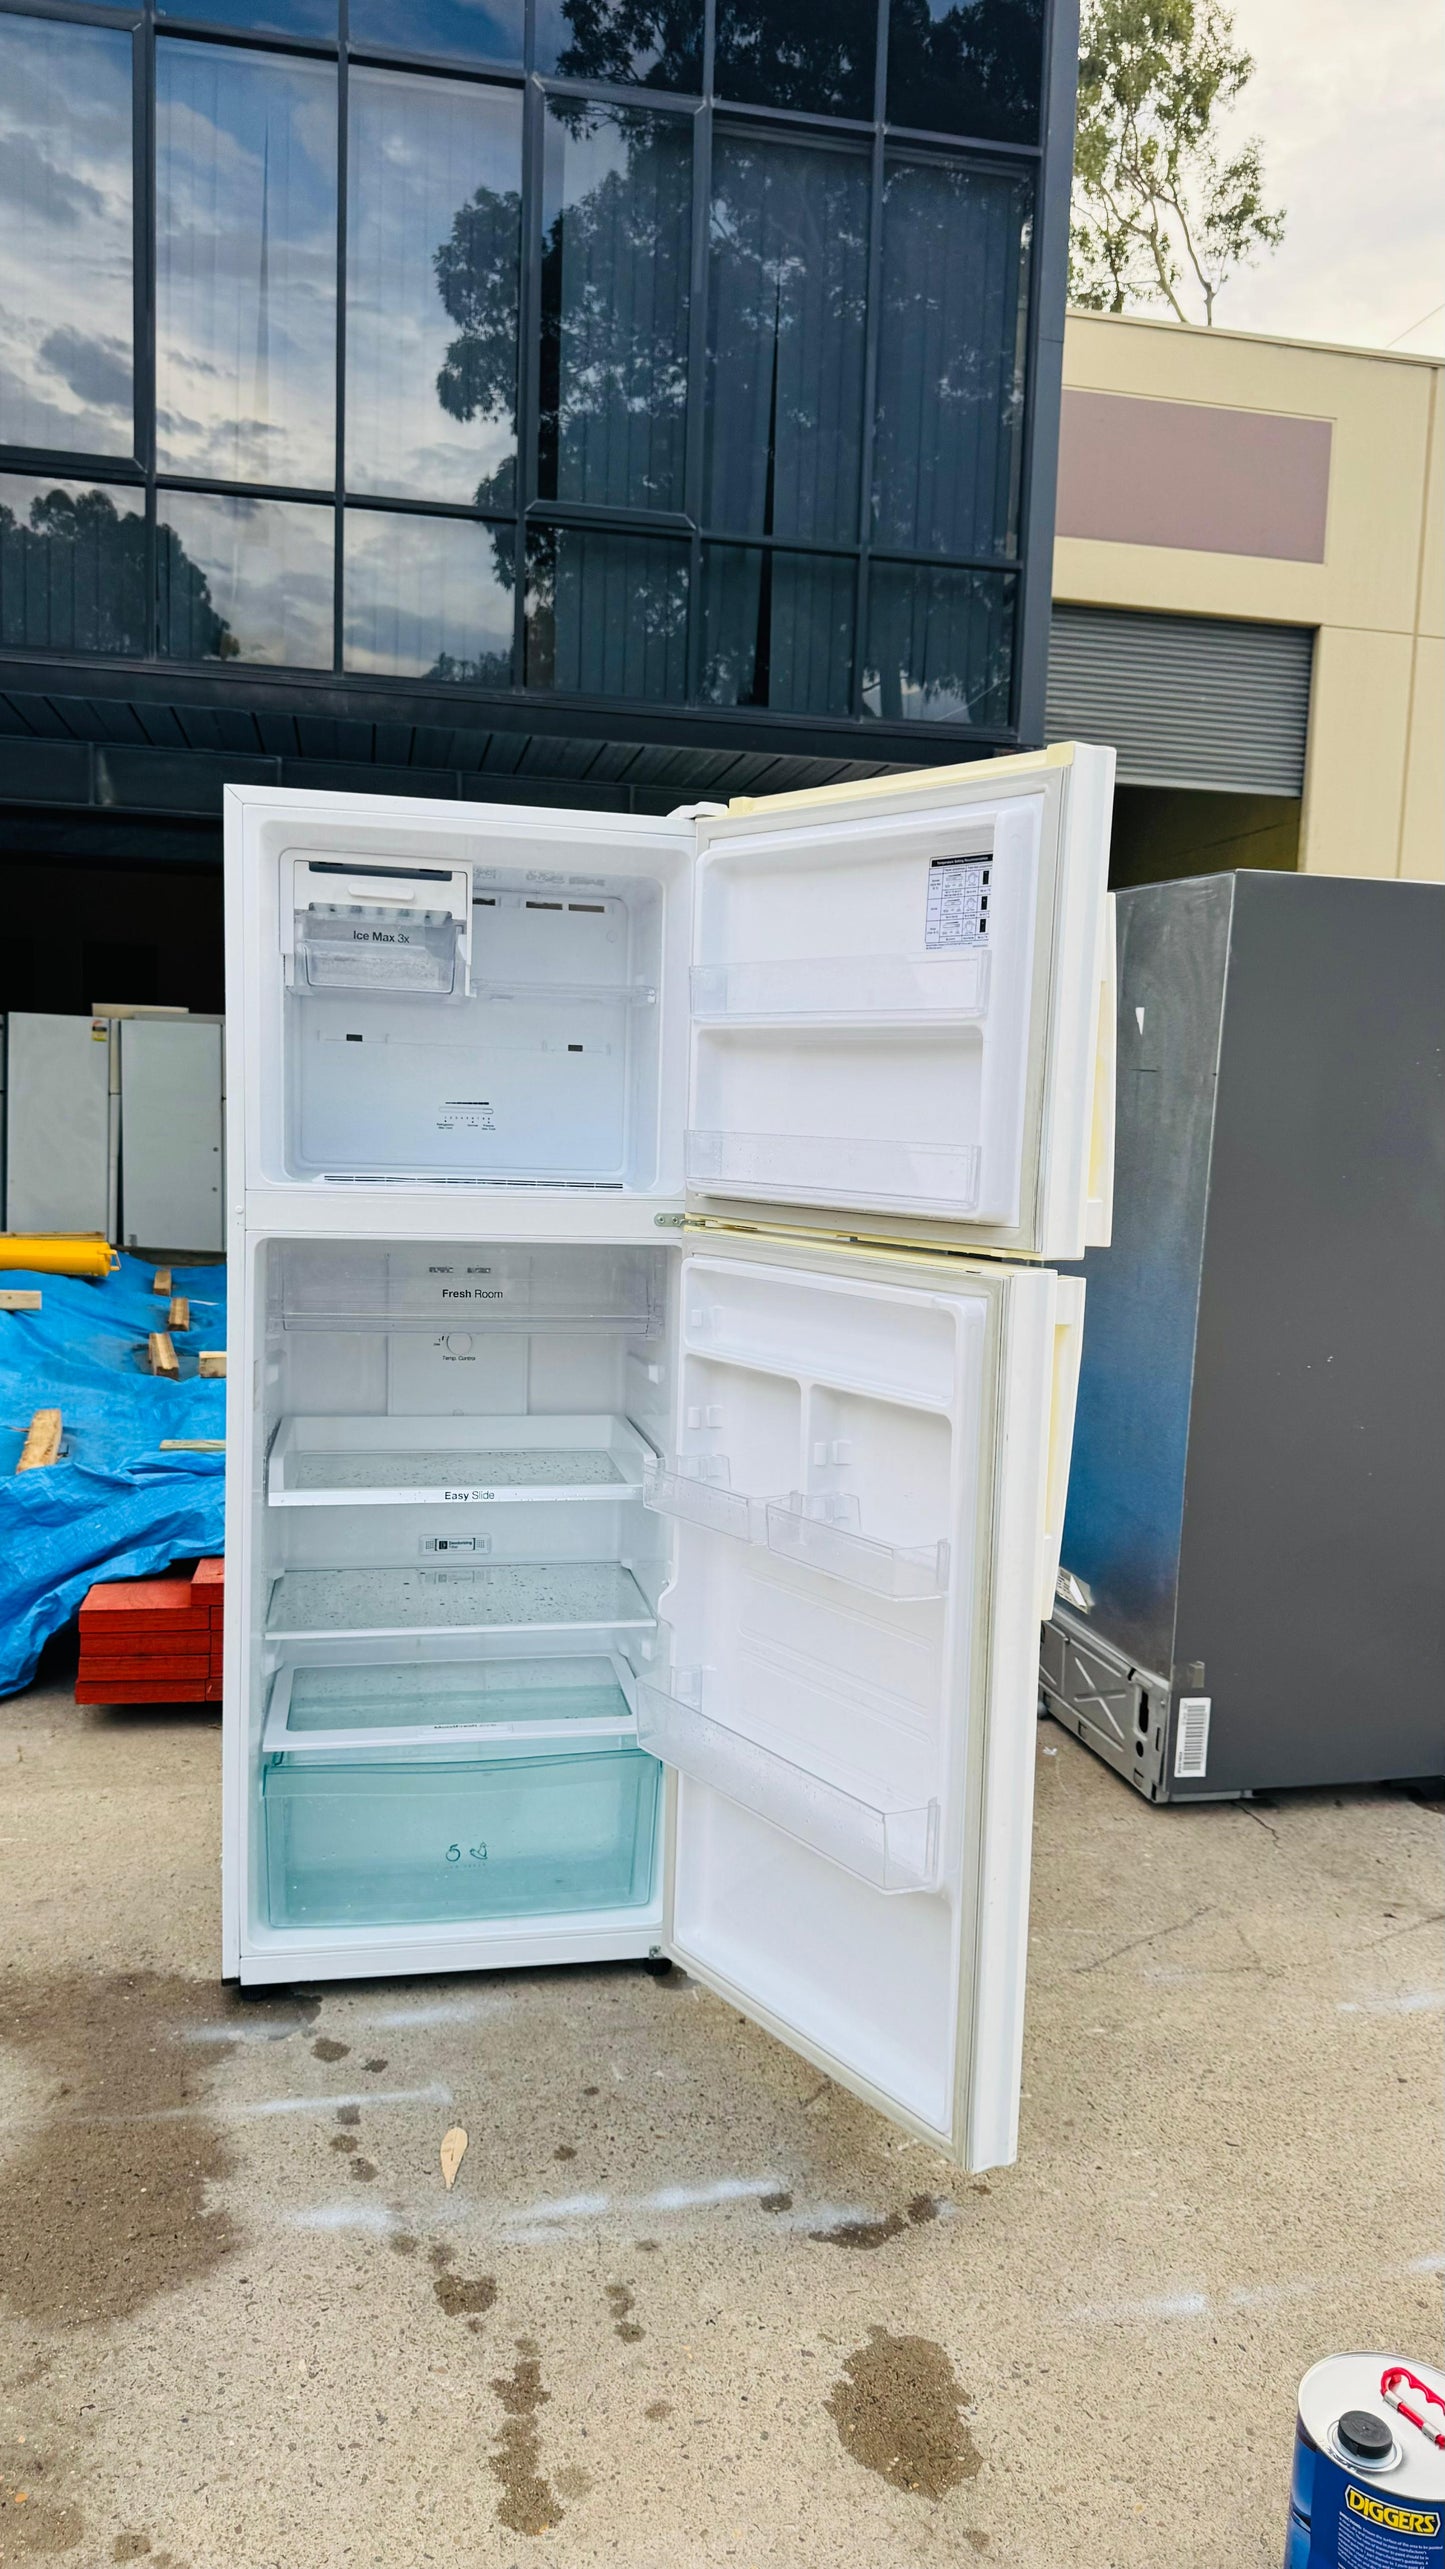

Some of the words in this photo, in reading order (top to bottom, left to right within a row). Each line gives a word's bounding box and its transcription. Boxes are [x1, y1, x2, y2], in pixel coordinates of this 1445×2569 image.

[353, 930, 370, 941] Ice
[372, 931, 395, 943] Max
[397, 933, 410, 944] 3x
[442, 1289, 472, 1298] Fresh
[474, 1289, 503, 1299] Room
[444, 1491, 469, 1501] Easy
[471, 1490, 495, 1500] Slide
[1349, 2490, 1435, 2533] DIGGERS
